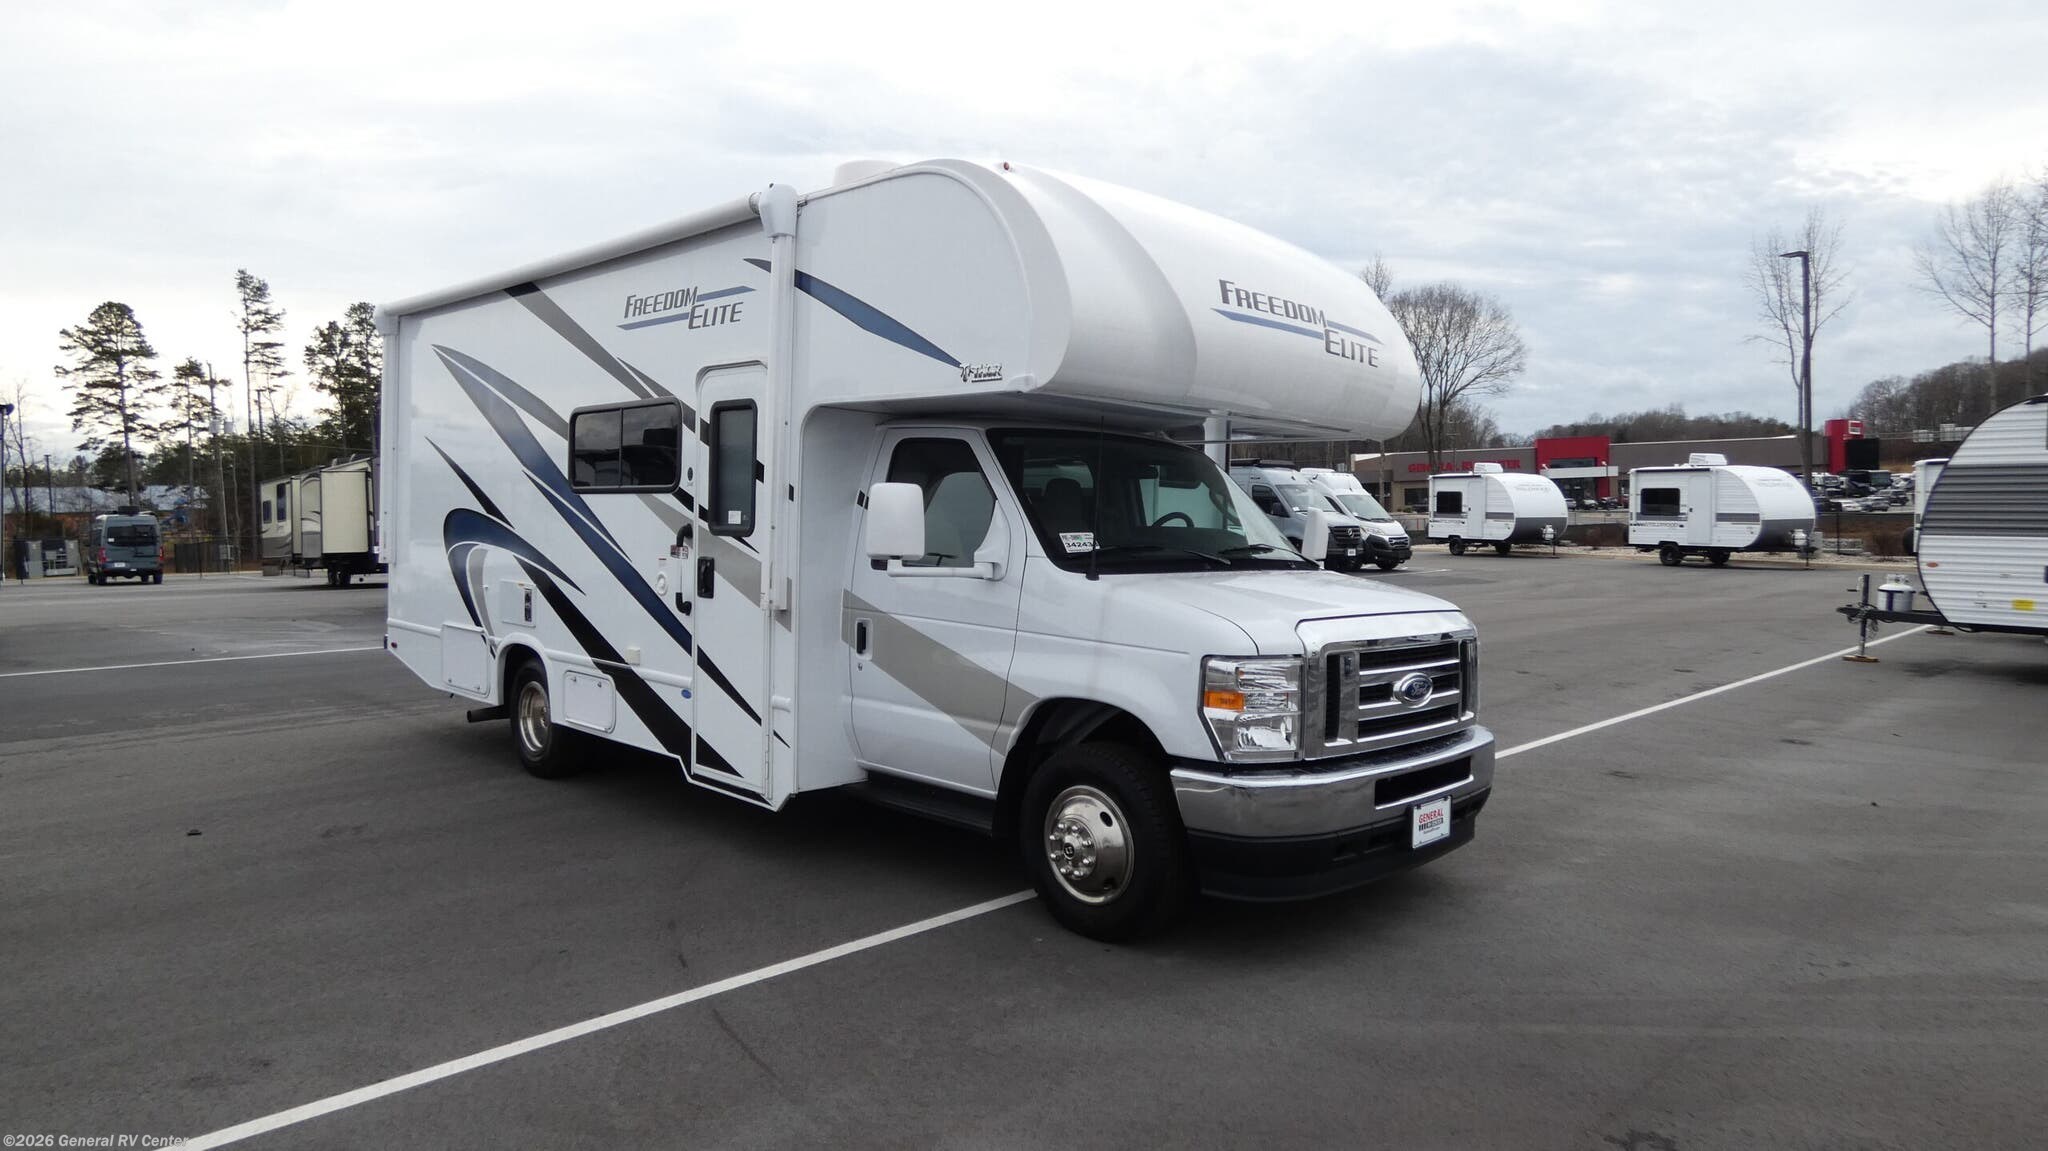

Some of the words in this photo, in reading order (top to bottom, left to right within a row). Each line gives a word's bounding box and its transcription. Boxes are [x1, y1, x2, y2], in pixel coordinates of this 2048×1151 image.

[624, 286, 698, 319] FREEDOM
[688, 302, 744, 330] ELITE
[1219, 279, 1327, 328] FREEDOM
[1325, 329, 1378, 368] ELITE
[1418, 808, 1444, 824] GENERAL
